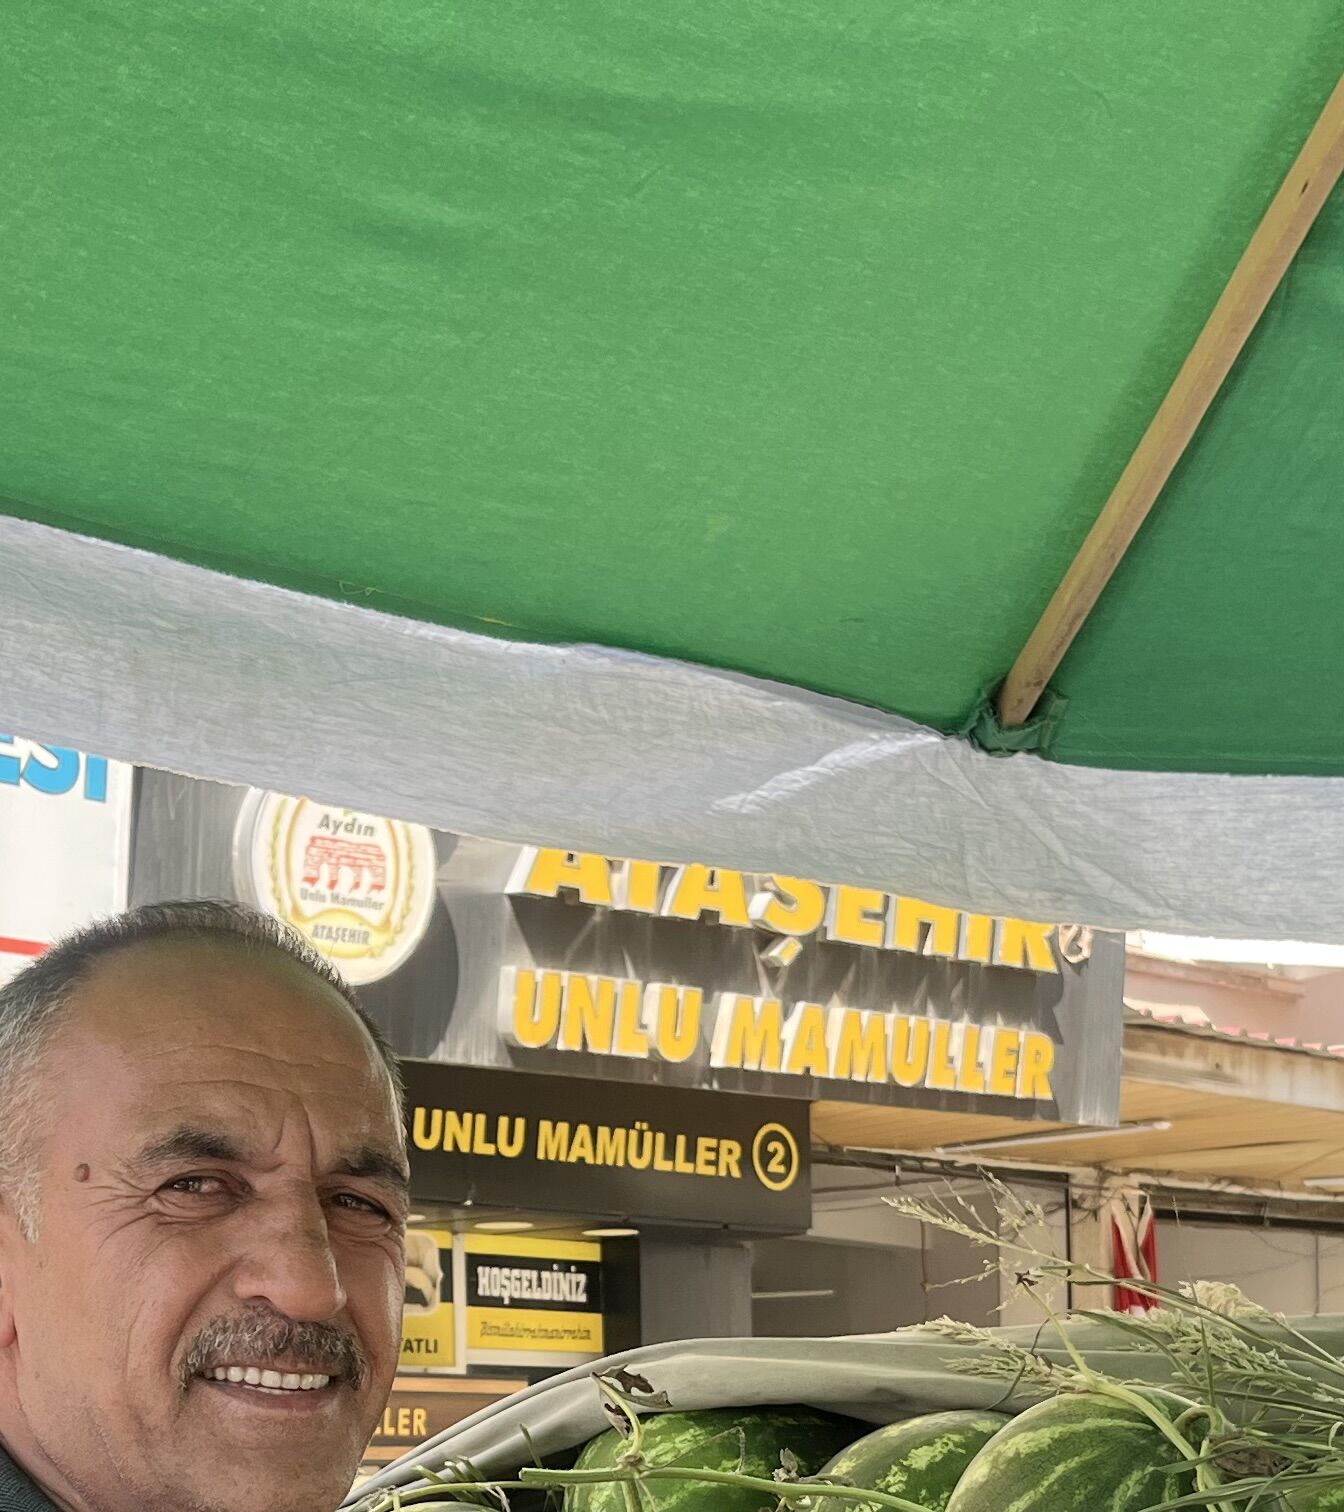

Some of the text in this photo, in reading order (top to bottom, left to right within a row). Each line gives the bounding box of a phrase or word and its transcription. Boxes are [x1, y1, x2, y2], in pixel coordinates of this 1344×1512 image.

[508, 967, 1054, 1098] UNLU MAMULLER
[412, 1106, 526, 1159] UNLU
[536, 1120, 743, 1180] MAMÜLLER
[476, 1262, 588, 1305] HOŞGELDİNİZ
[399, 1337, 439, 1354] ATLI
